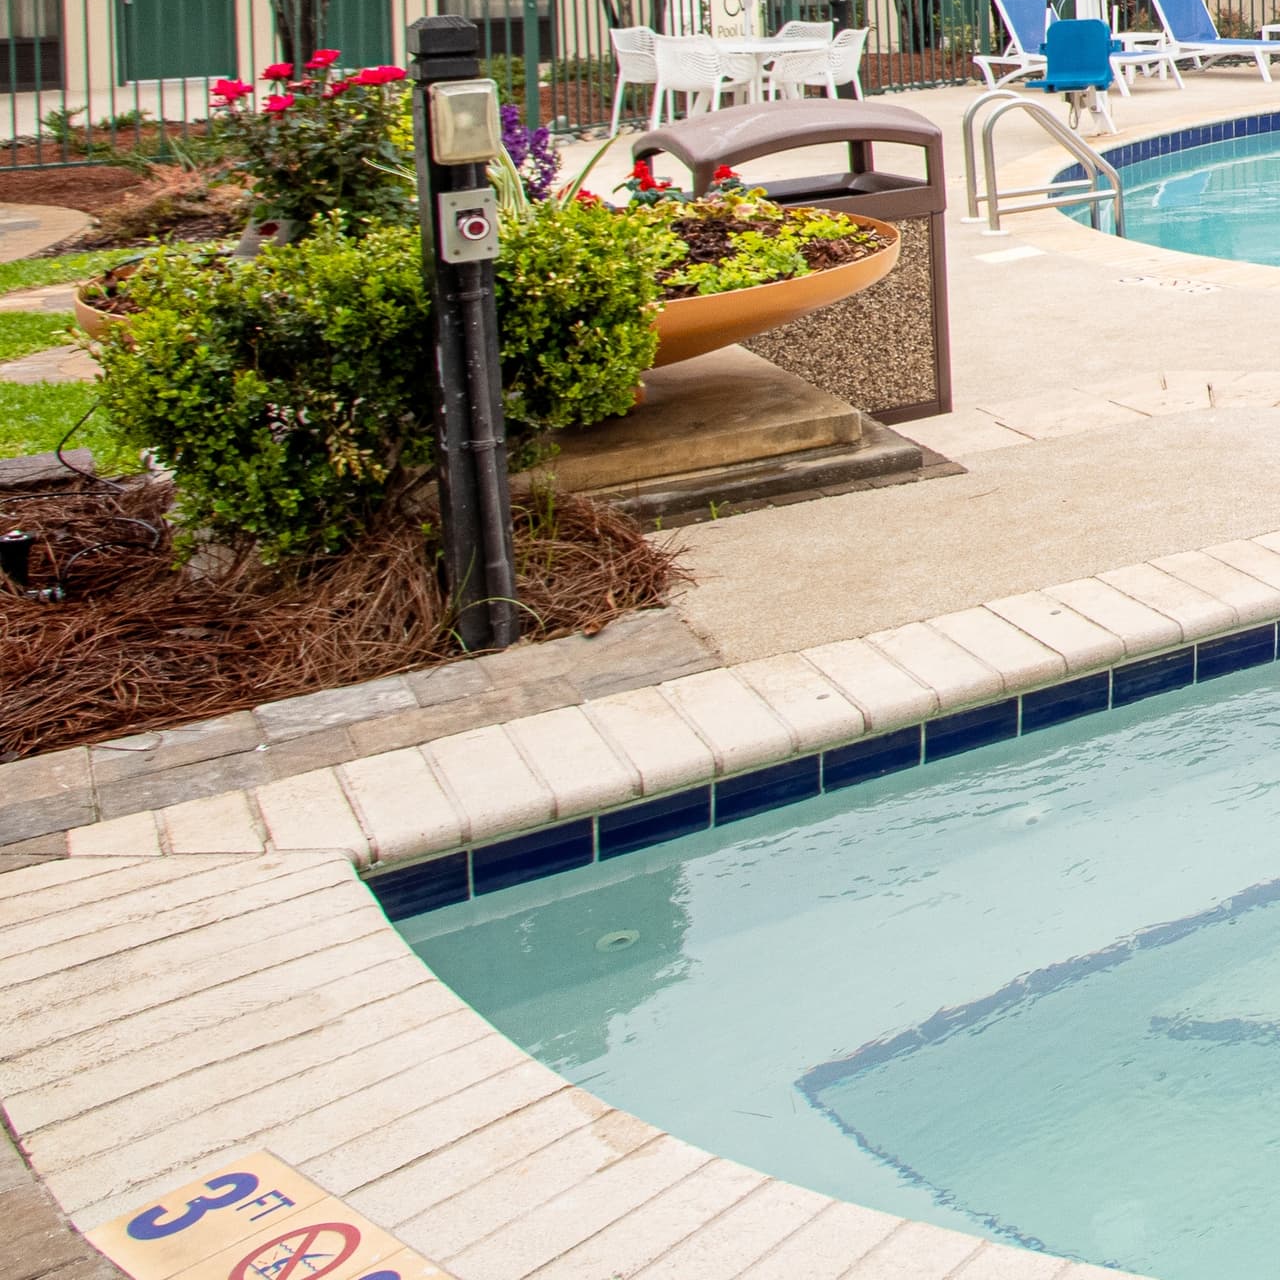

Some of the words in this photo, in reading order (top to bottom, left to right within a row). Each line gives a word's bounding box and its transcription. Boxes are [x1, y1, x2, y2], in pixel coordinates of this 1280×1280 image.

[718, 24, 738, 38] Pool
[126, 1171, 260, 1241] 3
[236, 1188, 296, 1222] FT
